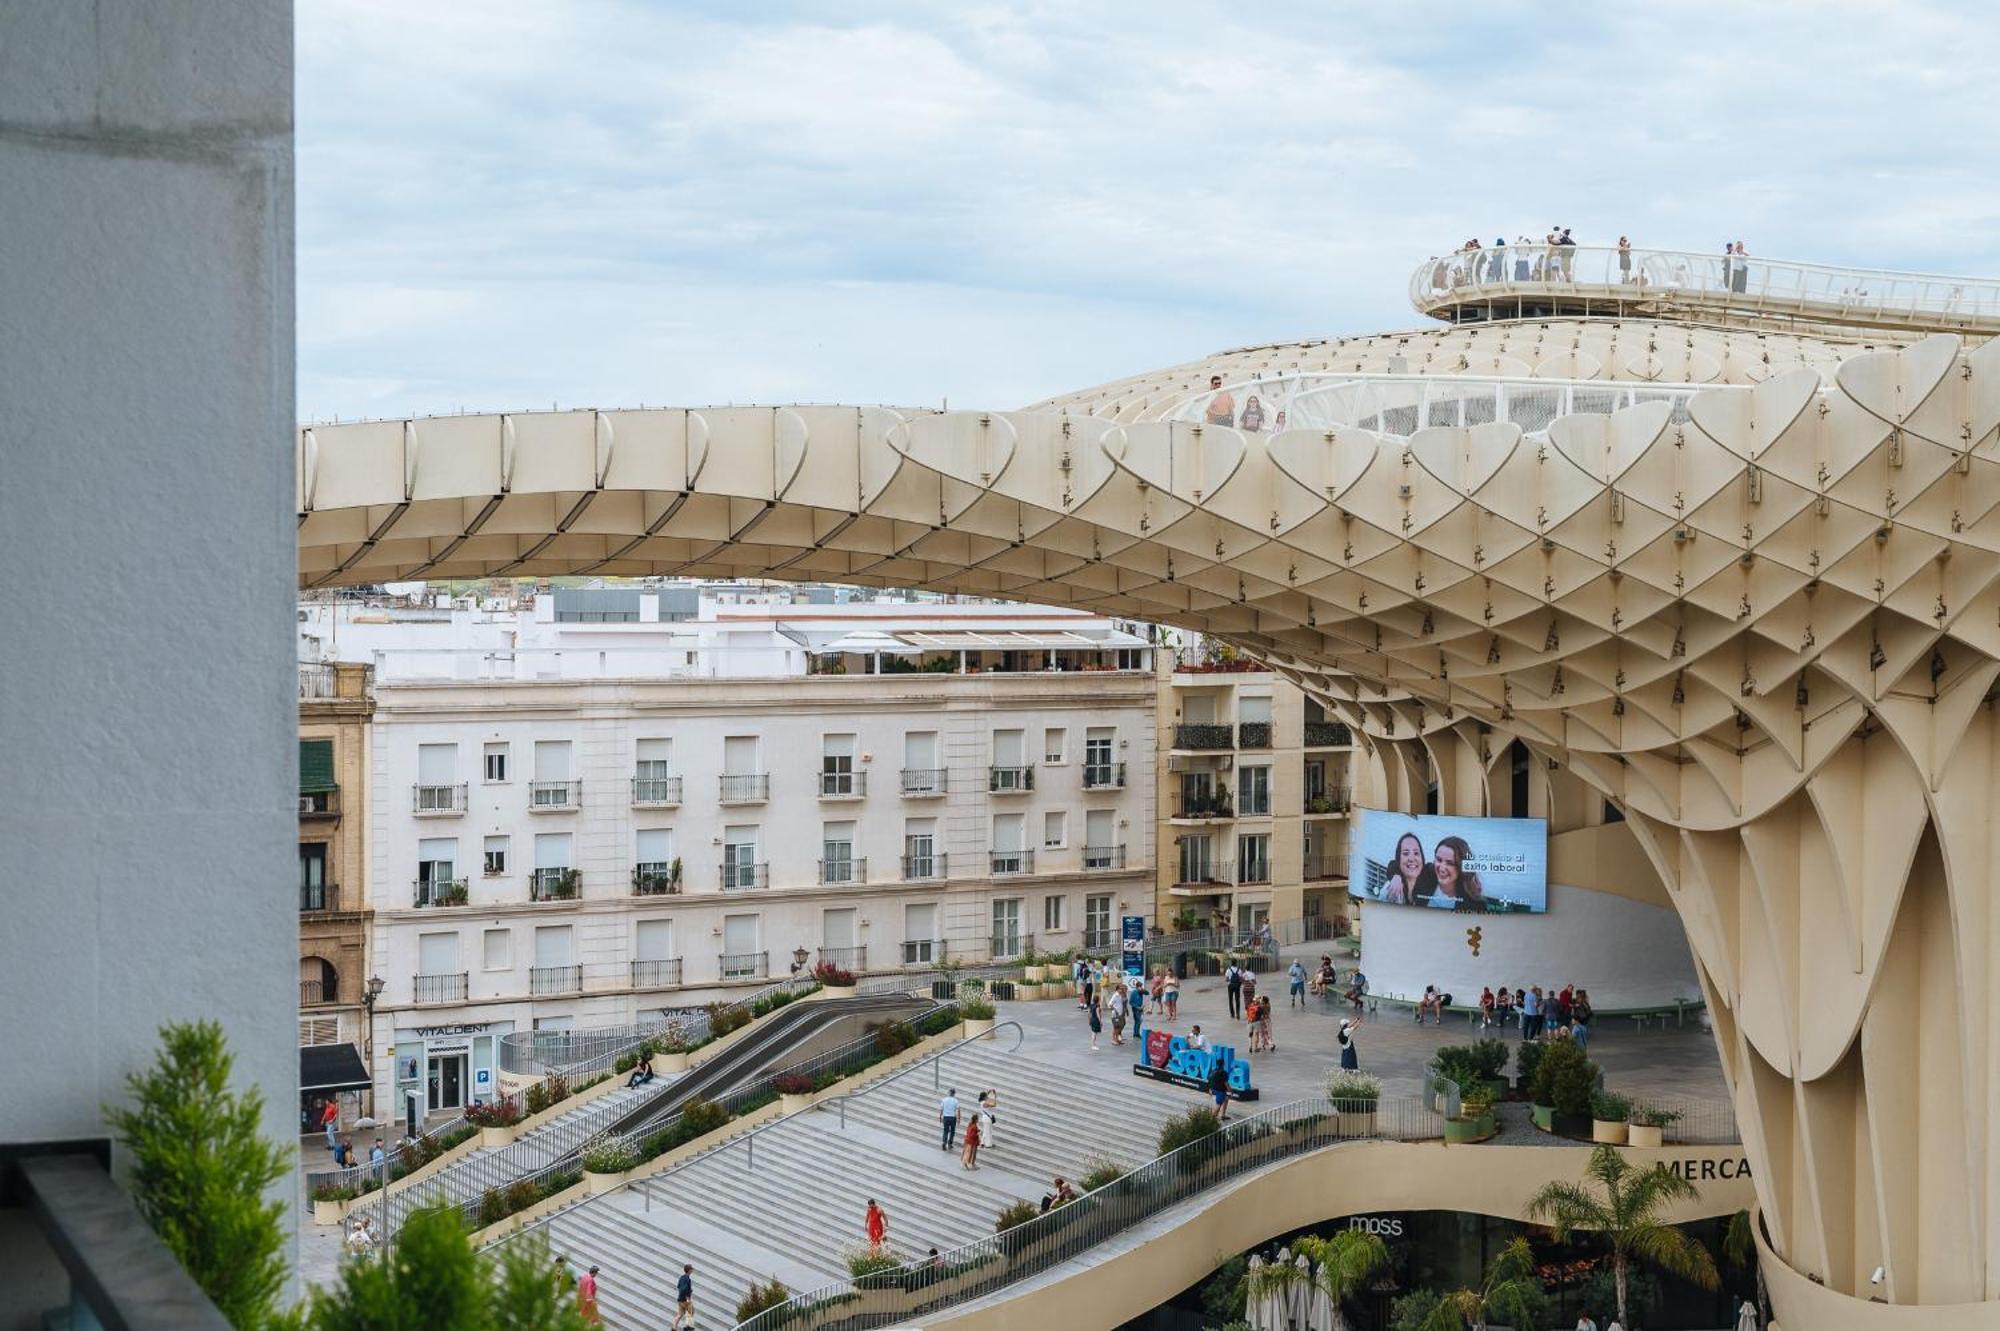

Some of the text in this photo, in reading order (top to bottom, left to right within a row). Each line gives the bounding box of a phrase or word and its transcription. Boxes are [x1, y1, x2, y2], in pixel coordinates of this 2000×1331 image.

[1490, 862, 1525, 872] laboral
[416, 1023, 490, 1037] VITALDENT
[1657, 1158, 1752, 1180] MERCA
[1350, 1216, 1402, 1236] moss
